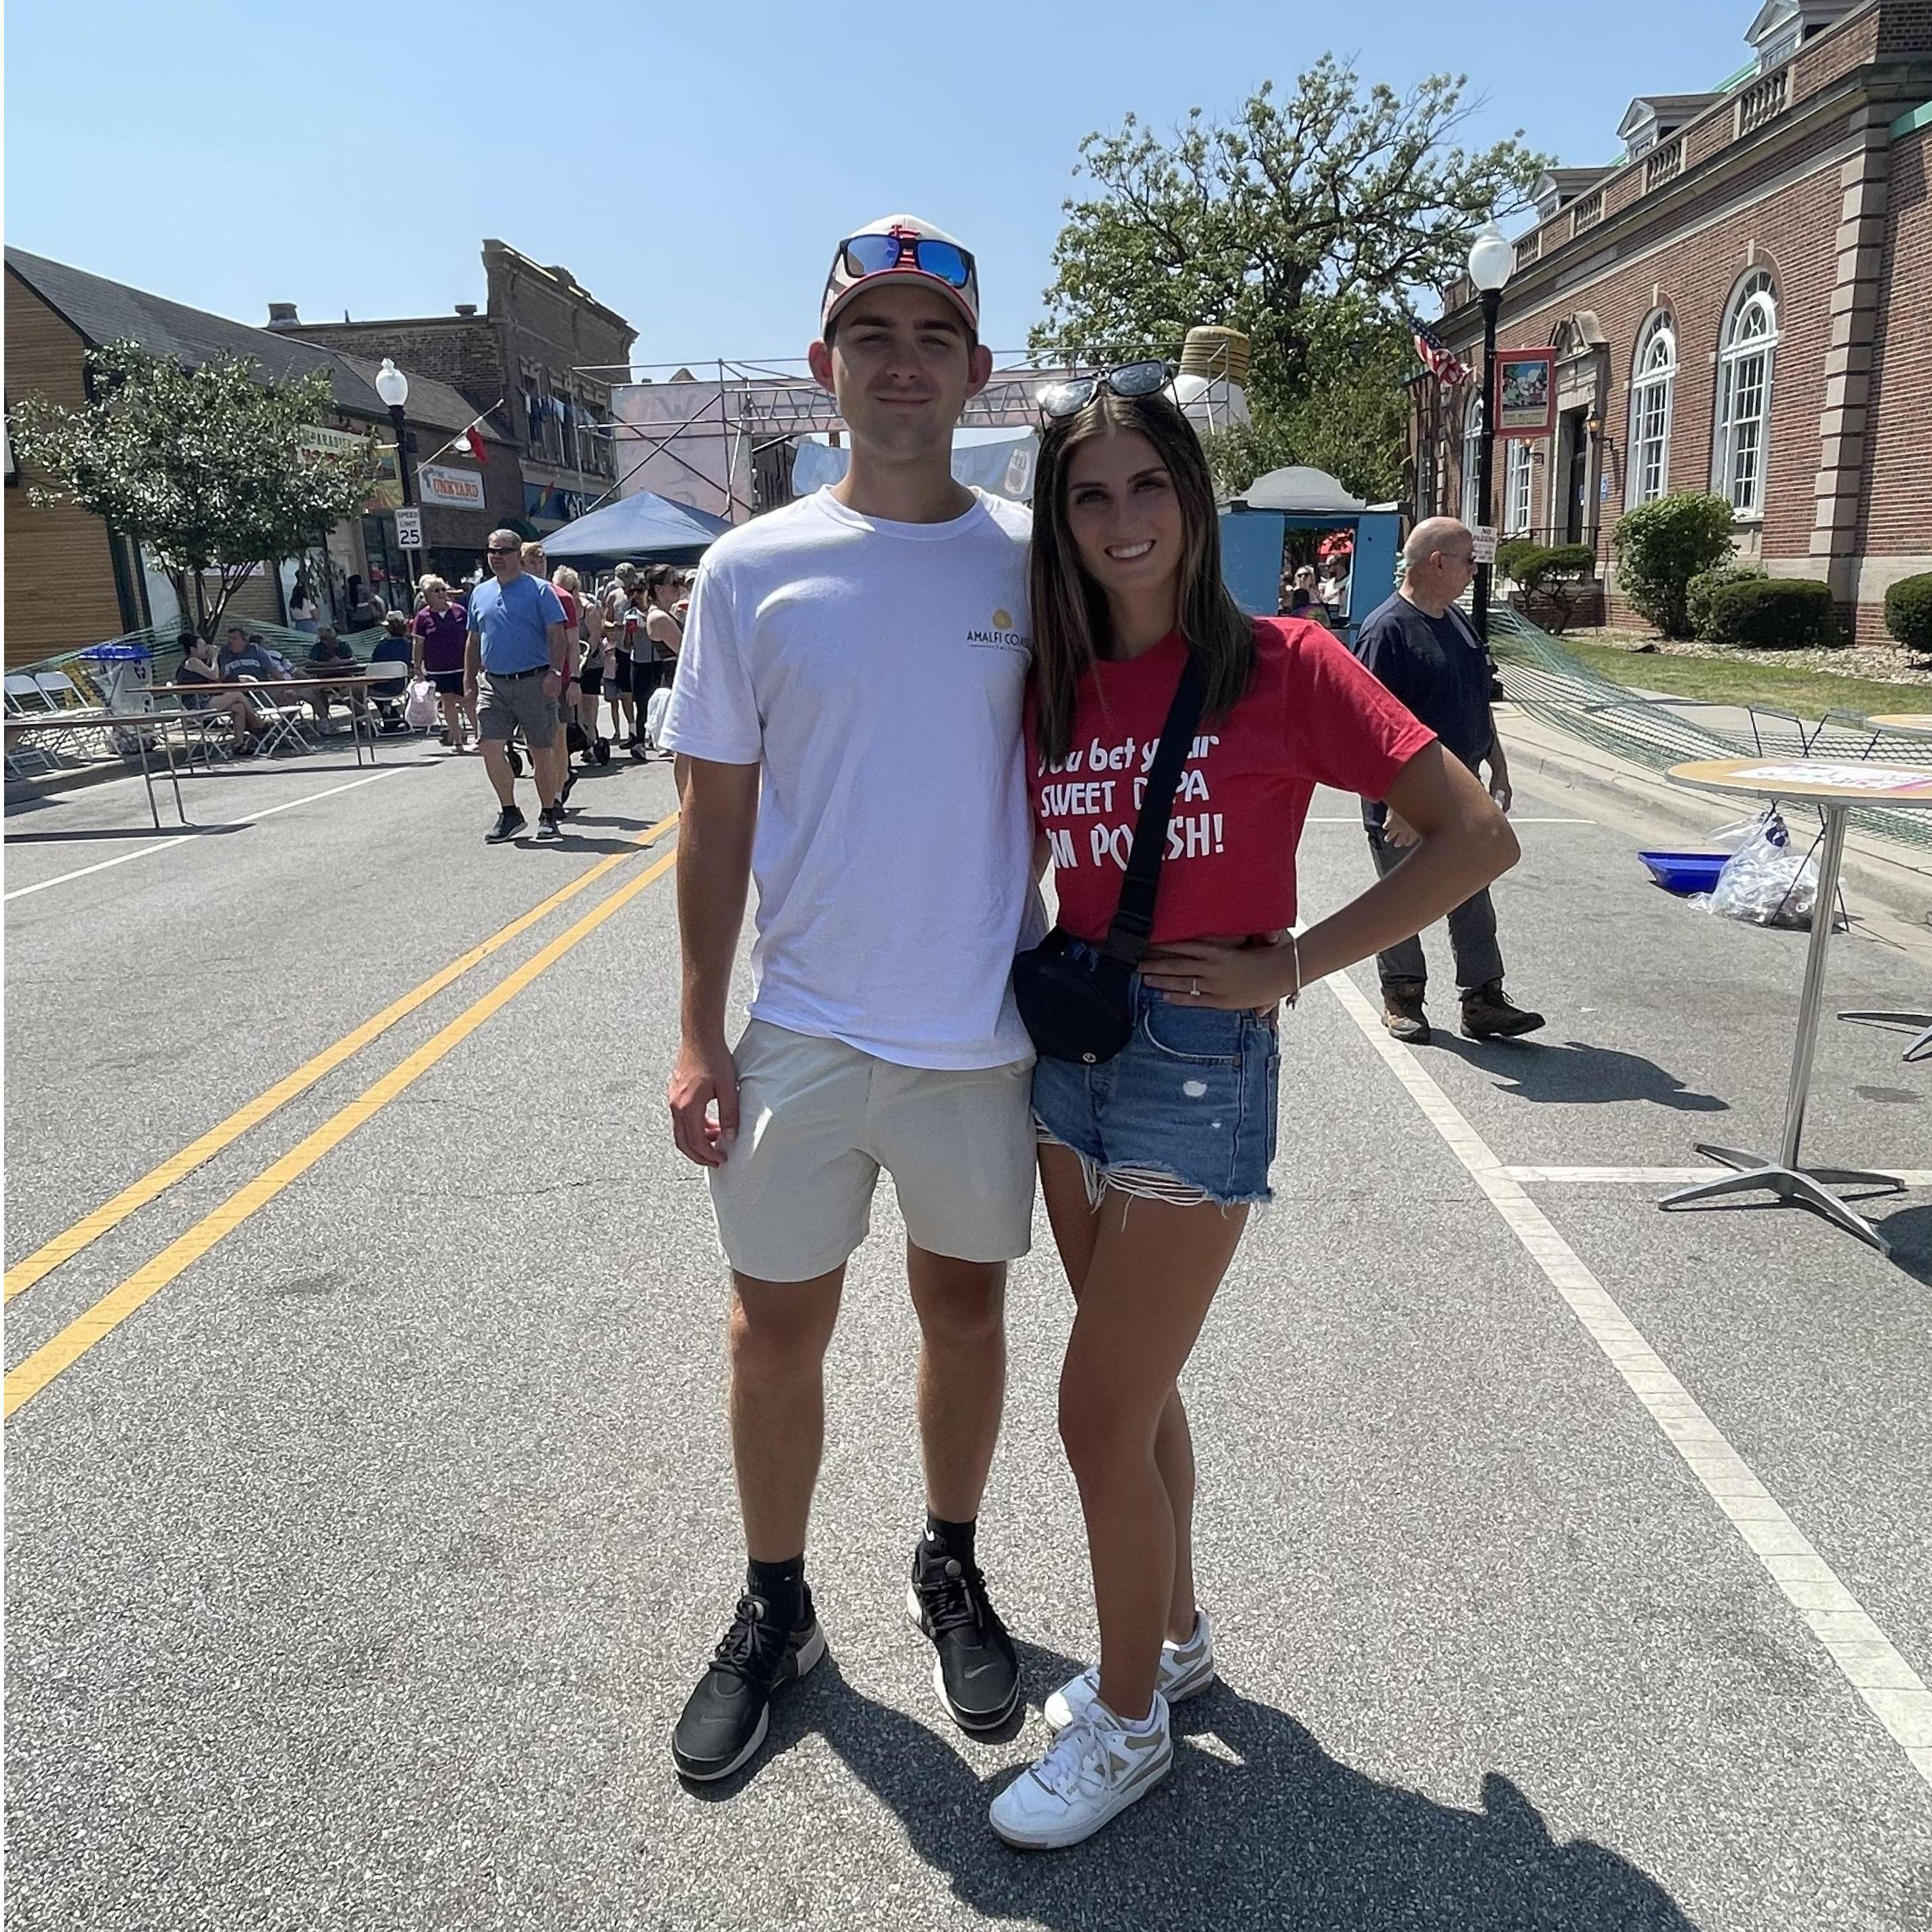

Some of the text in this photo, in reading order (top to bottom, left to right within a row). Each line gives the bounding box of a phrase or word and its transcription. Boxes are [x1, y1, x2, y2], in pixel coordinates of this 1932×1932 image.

[400, 529, 420, 544] 25
[967, 630, 1003, 643] AMALFI
[1089, 737, 1135, 771] bet
[1041, 780, 1116, 818] SWEET
[1090, 813, 1224, 872] POSH!
